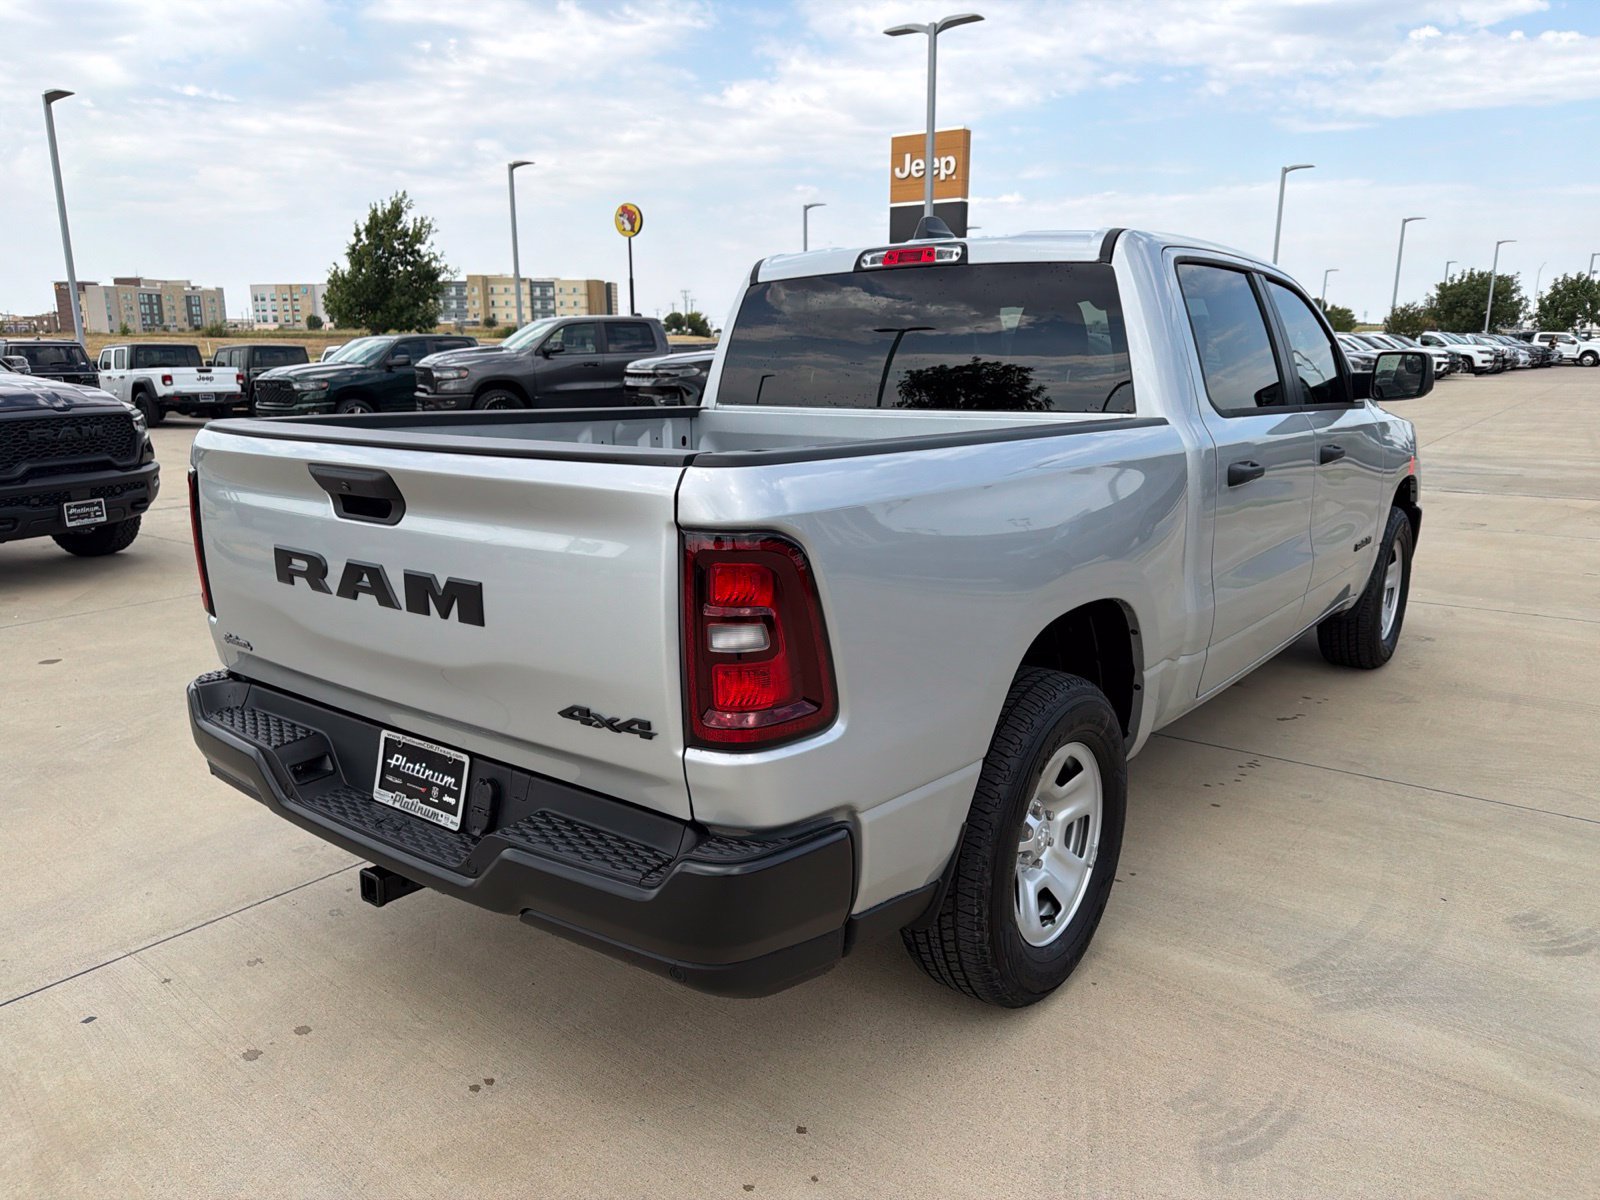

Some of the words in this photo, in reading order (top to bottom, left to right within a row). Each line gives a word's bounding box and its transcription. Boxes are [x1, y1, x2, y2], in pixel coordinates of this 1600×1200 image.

[274, 544, 485, 627] RAM
[387, 754, 458, 791] Platinum
[392, 793, 442, 822] Platinum
